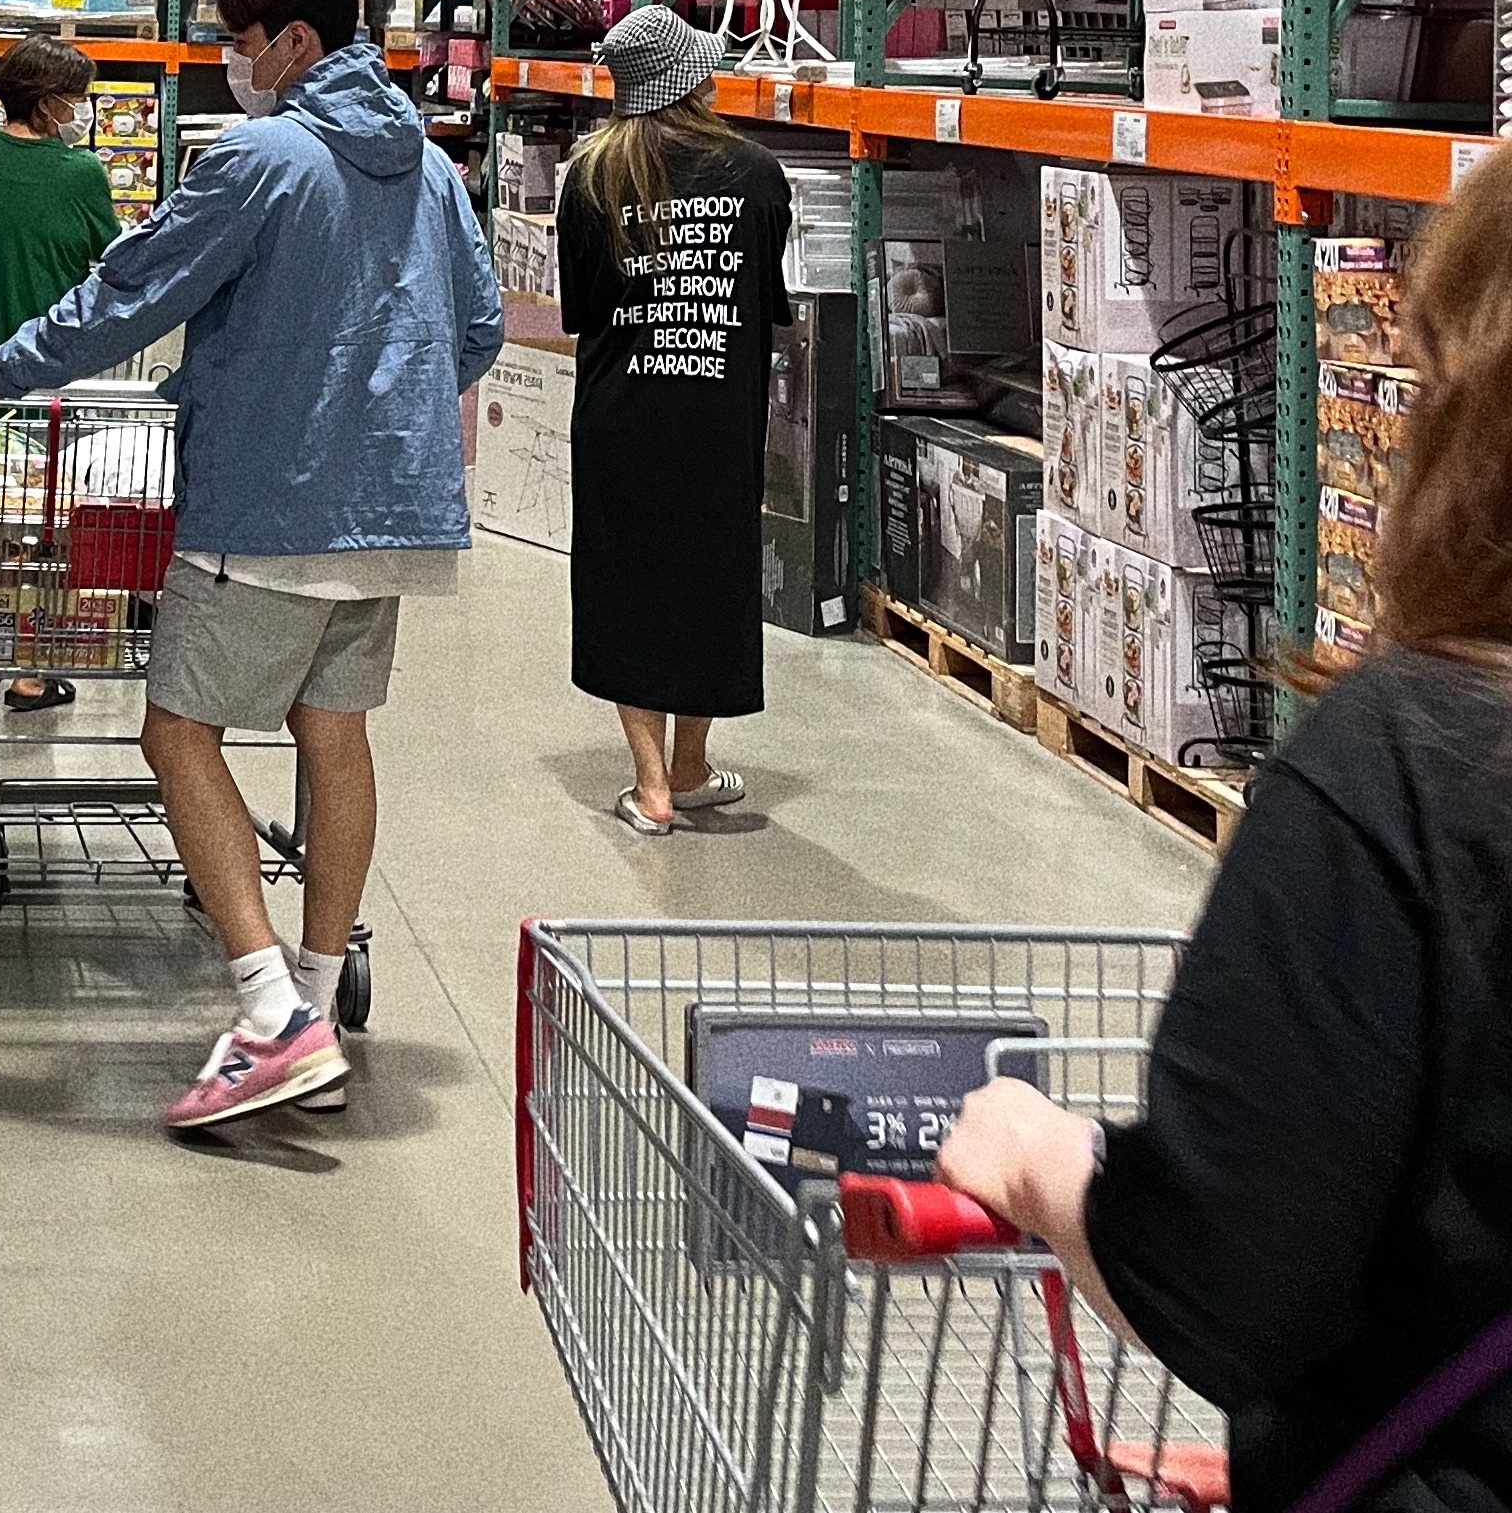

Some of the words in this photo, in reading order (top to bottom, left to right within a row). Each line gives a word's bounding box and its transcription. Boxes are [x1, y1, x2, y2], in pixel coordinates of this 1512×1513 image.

[636, 196, 745, 224] EVERYBODY
[659, 223, 706, 246] LIVES
[709, 223, 734, 244] BY
[623, 254, 654, 277] THE
[656, 249, 717, 271] SWEAT
[719, 250, 744, 272] OF
[653, 275, 676, 297] HIS
[680, 275, 735, 298] BROW
[612, 305, 644, 326] THE
[647, 301, 698, 323] EARTH
[701, 302, 742, 327] WILL
[653, 327, 727, 352] BECOME
[626, 354, 640, 375] A
[643, 354, 726, 379] PARADISE
